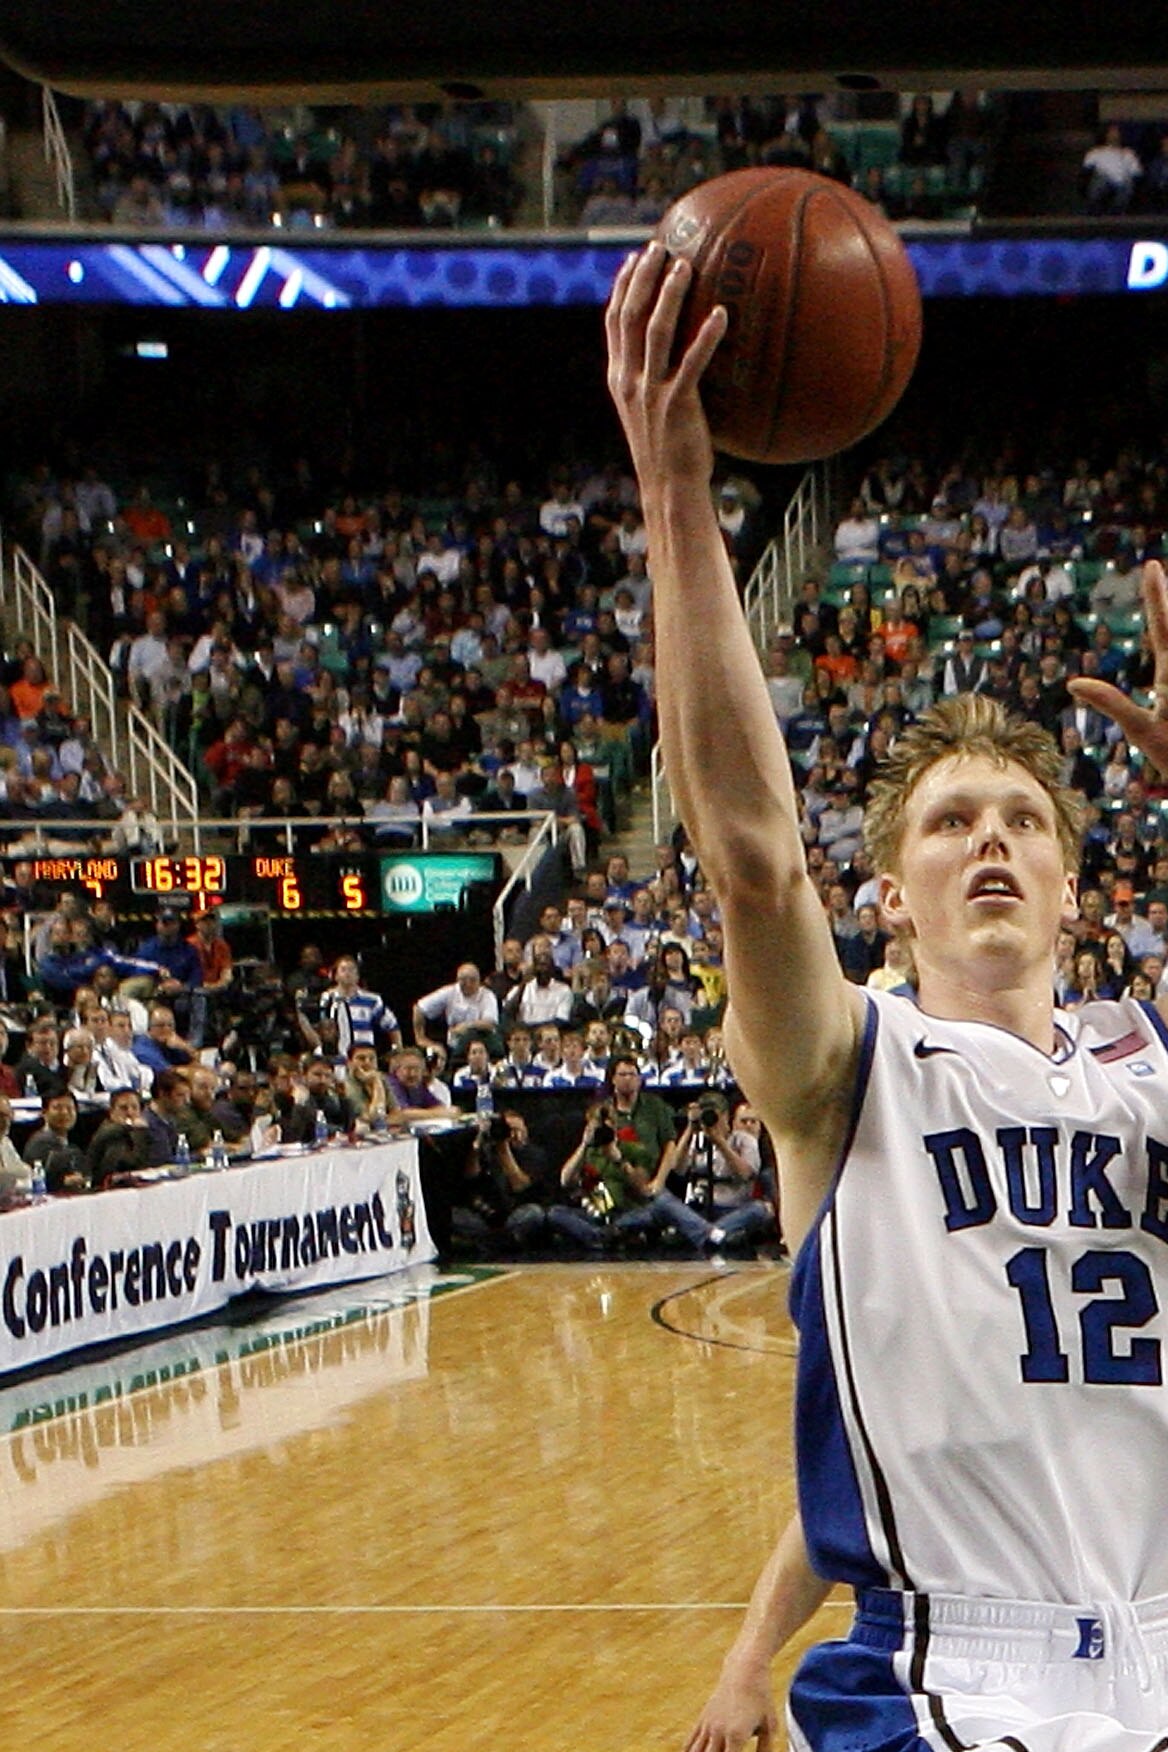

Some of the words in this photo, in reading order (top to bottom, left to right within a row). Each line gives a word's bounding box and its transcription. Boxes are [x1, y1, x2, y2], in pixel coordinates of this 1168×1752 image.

[34, 860, 118, 880] MARYLAND
[145, 856, 222, 892] 16:32
[255, 858, 295, 877] DUKE
[282, 877, 300, 910] 6
[342, 875, 363, 909] 5
[2, 1236, 201, 1339] Conference
[209, 1191, 393, 1283] Tournament
[1005, 1246, 1164, 1387] 12
